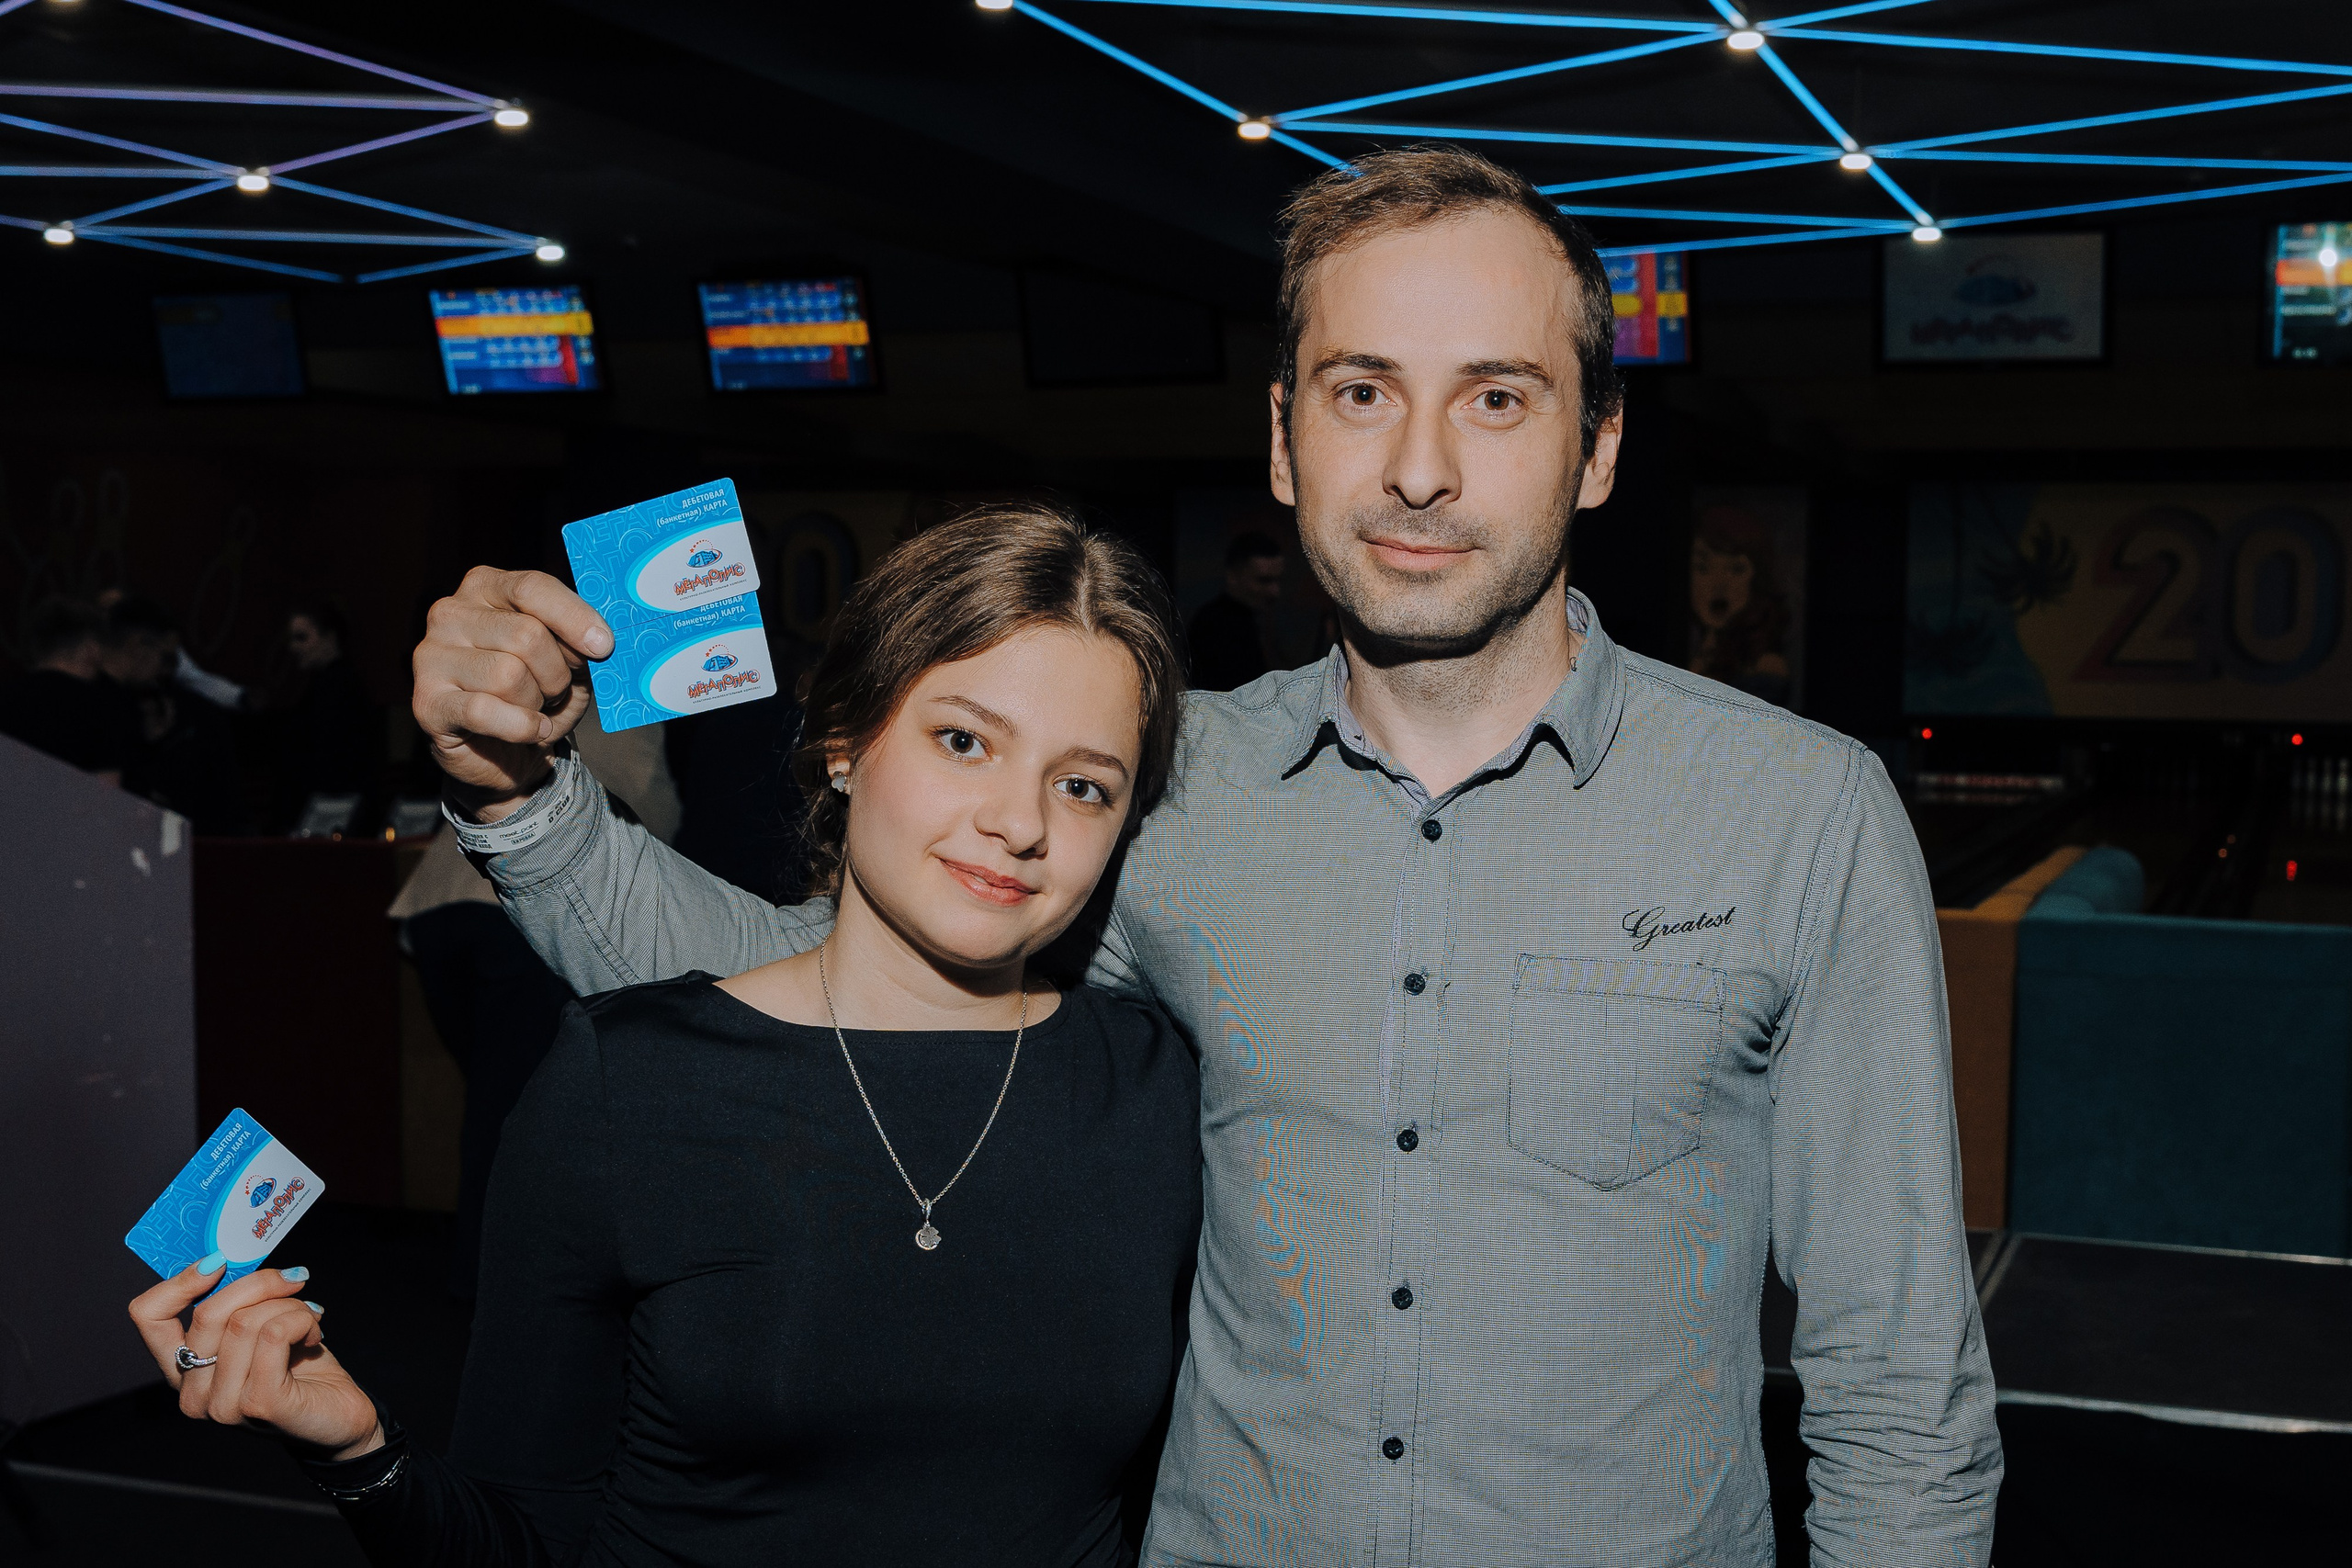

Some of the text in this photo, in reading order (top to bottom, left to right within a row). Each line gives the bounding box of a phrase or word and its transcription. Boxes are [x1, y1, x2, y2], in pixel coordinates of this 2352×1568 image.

[656, 499, 728, 528] (банкетная) КАРТА
[682, 489, 725, 509] ДЕБЕТОВАЯ
[673, 561, 745, 596] МЕГАПОЛИС
[2072, 504, 2345, 685] 20
[673, 605, 746, 630] (банкетная) КАРТА
[687, 669, 761, 699] МЕГАПОЛИС
[1622, 907, 1736, 952] Greatest
[199, 1130, 252, 1190] (банкетная) КАРТА
[210, 1122, 243, 1161] ДЕБЕТОВАЯ
[251, 1176, 305, 1240] МЕГАПОЛИС
